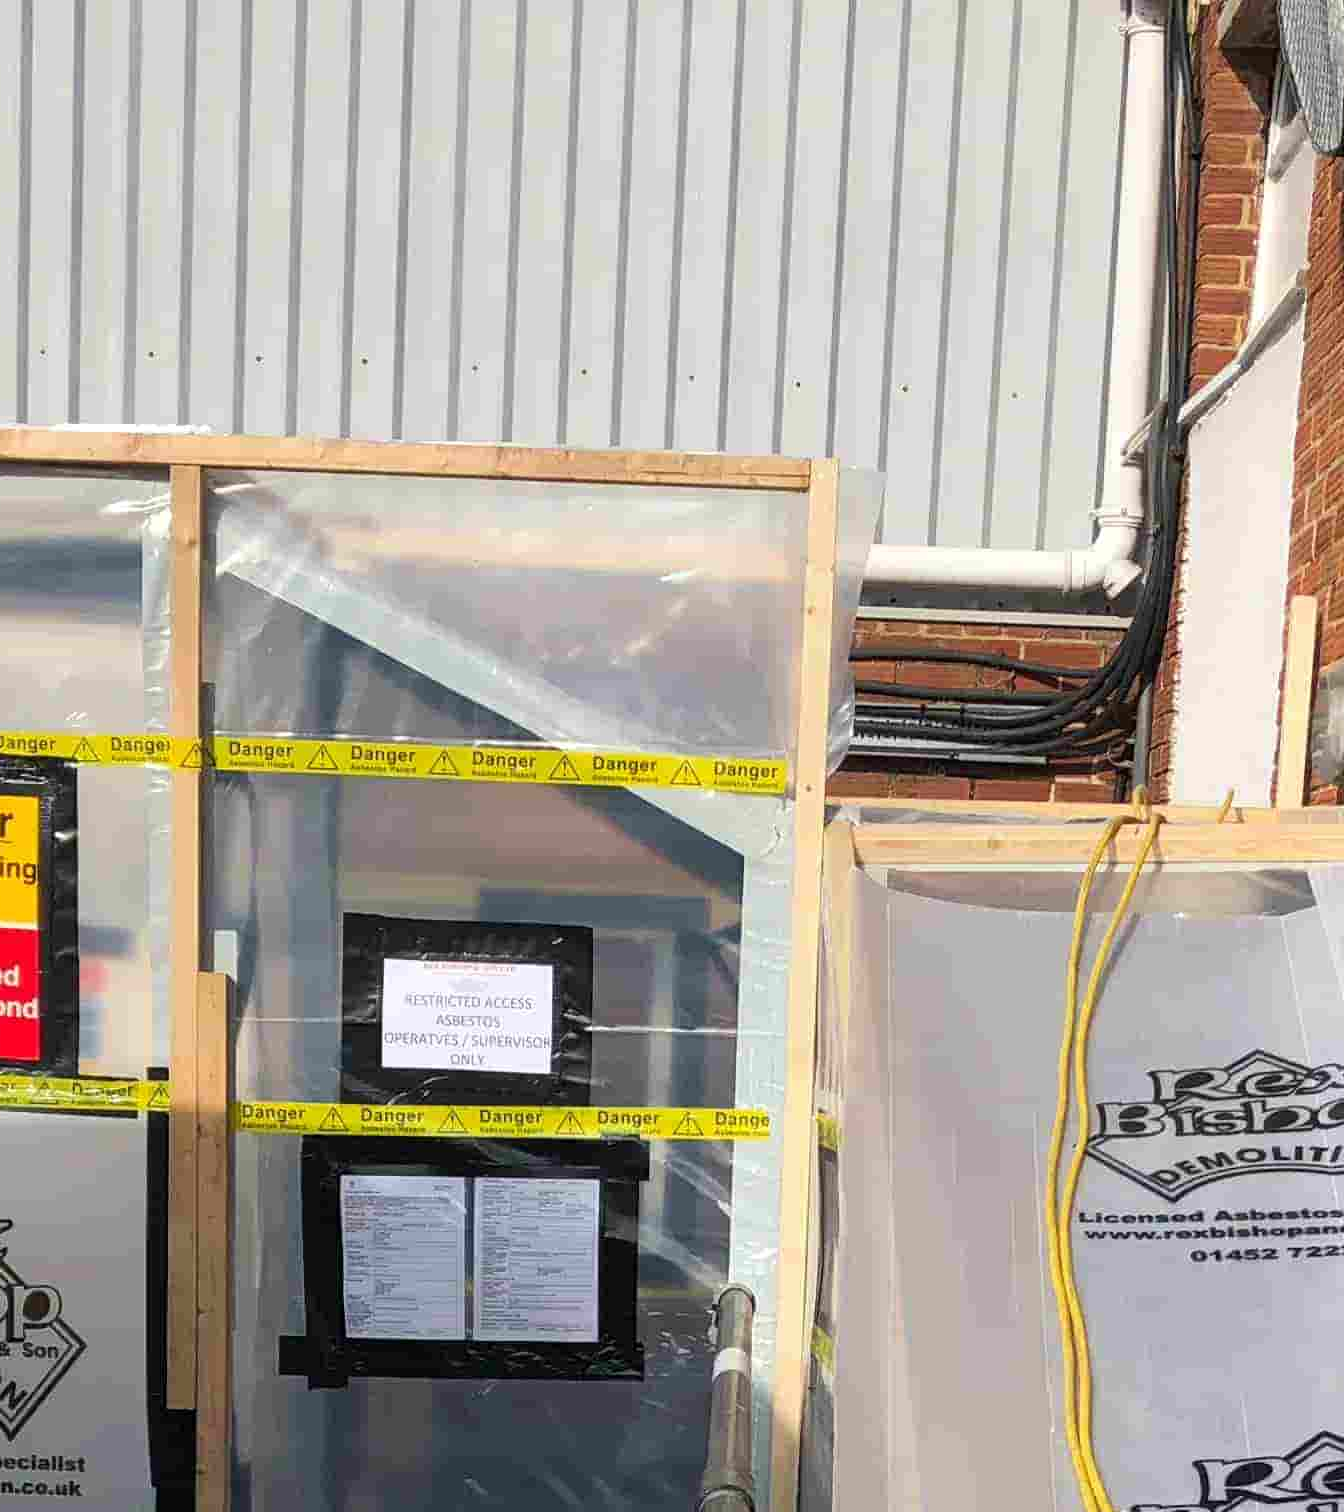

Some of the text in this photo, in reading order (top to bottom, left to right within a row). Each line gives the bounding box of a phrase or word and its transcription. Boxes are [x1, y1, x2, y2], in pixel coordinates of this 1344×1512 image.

[229, 742, 778, 780] Danger Danger Danger Danger Danger
[404, 994, 533, 1010] RESTRICTED ACCESS
[436, 1014, 501, 1028] ASBESTOS
[450, 1053, 485, 1066] ONLY
[241, 1104, 306, 1122] Danger
[360, 1107, 424, 1125] Danger
[480, 1109, 544, 1127] Danger
[597, 1111, 658, 1128] Danger
[1079, 1210, 1204, 1224] Licensed
[1214, 1207, 1344, 1223] Asbestos
[1190, 1249, 1279, 1263] 01452
[22, 1342, 58, 1359] Son
